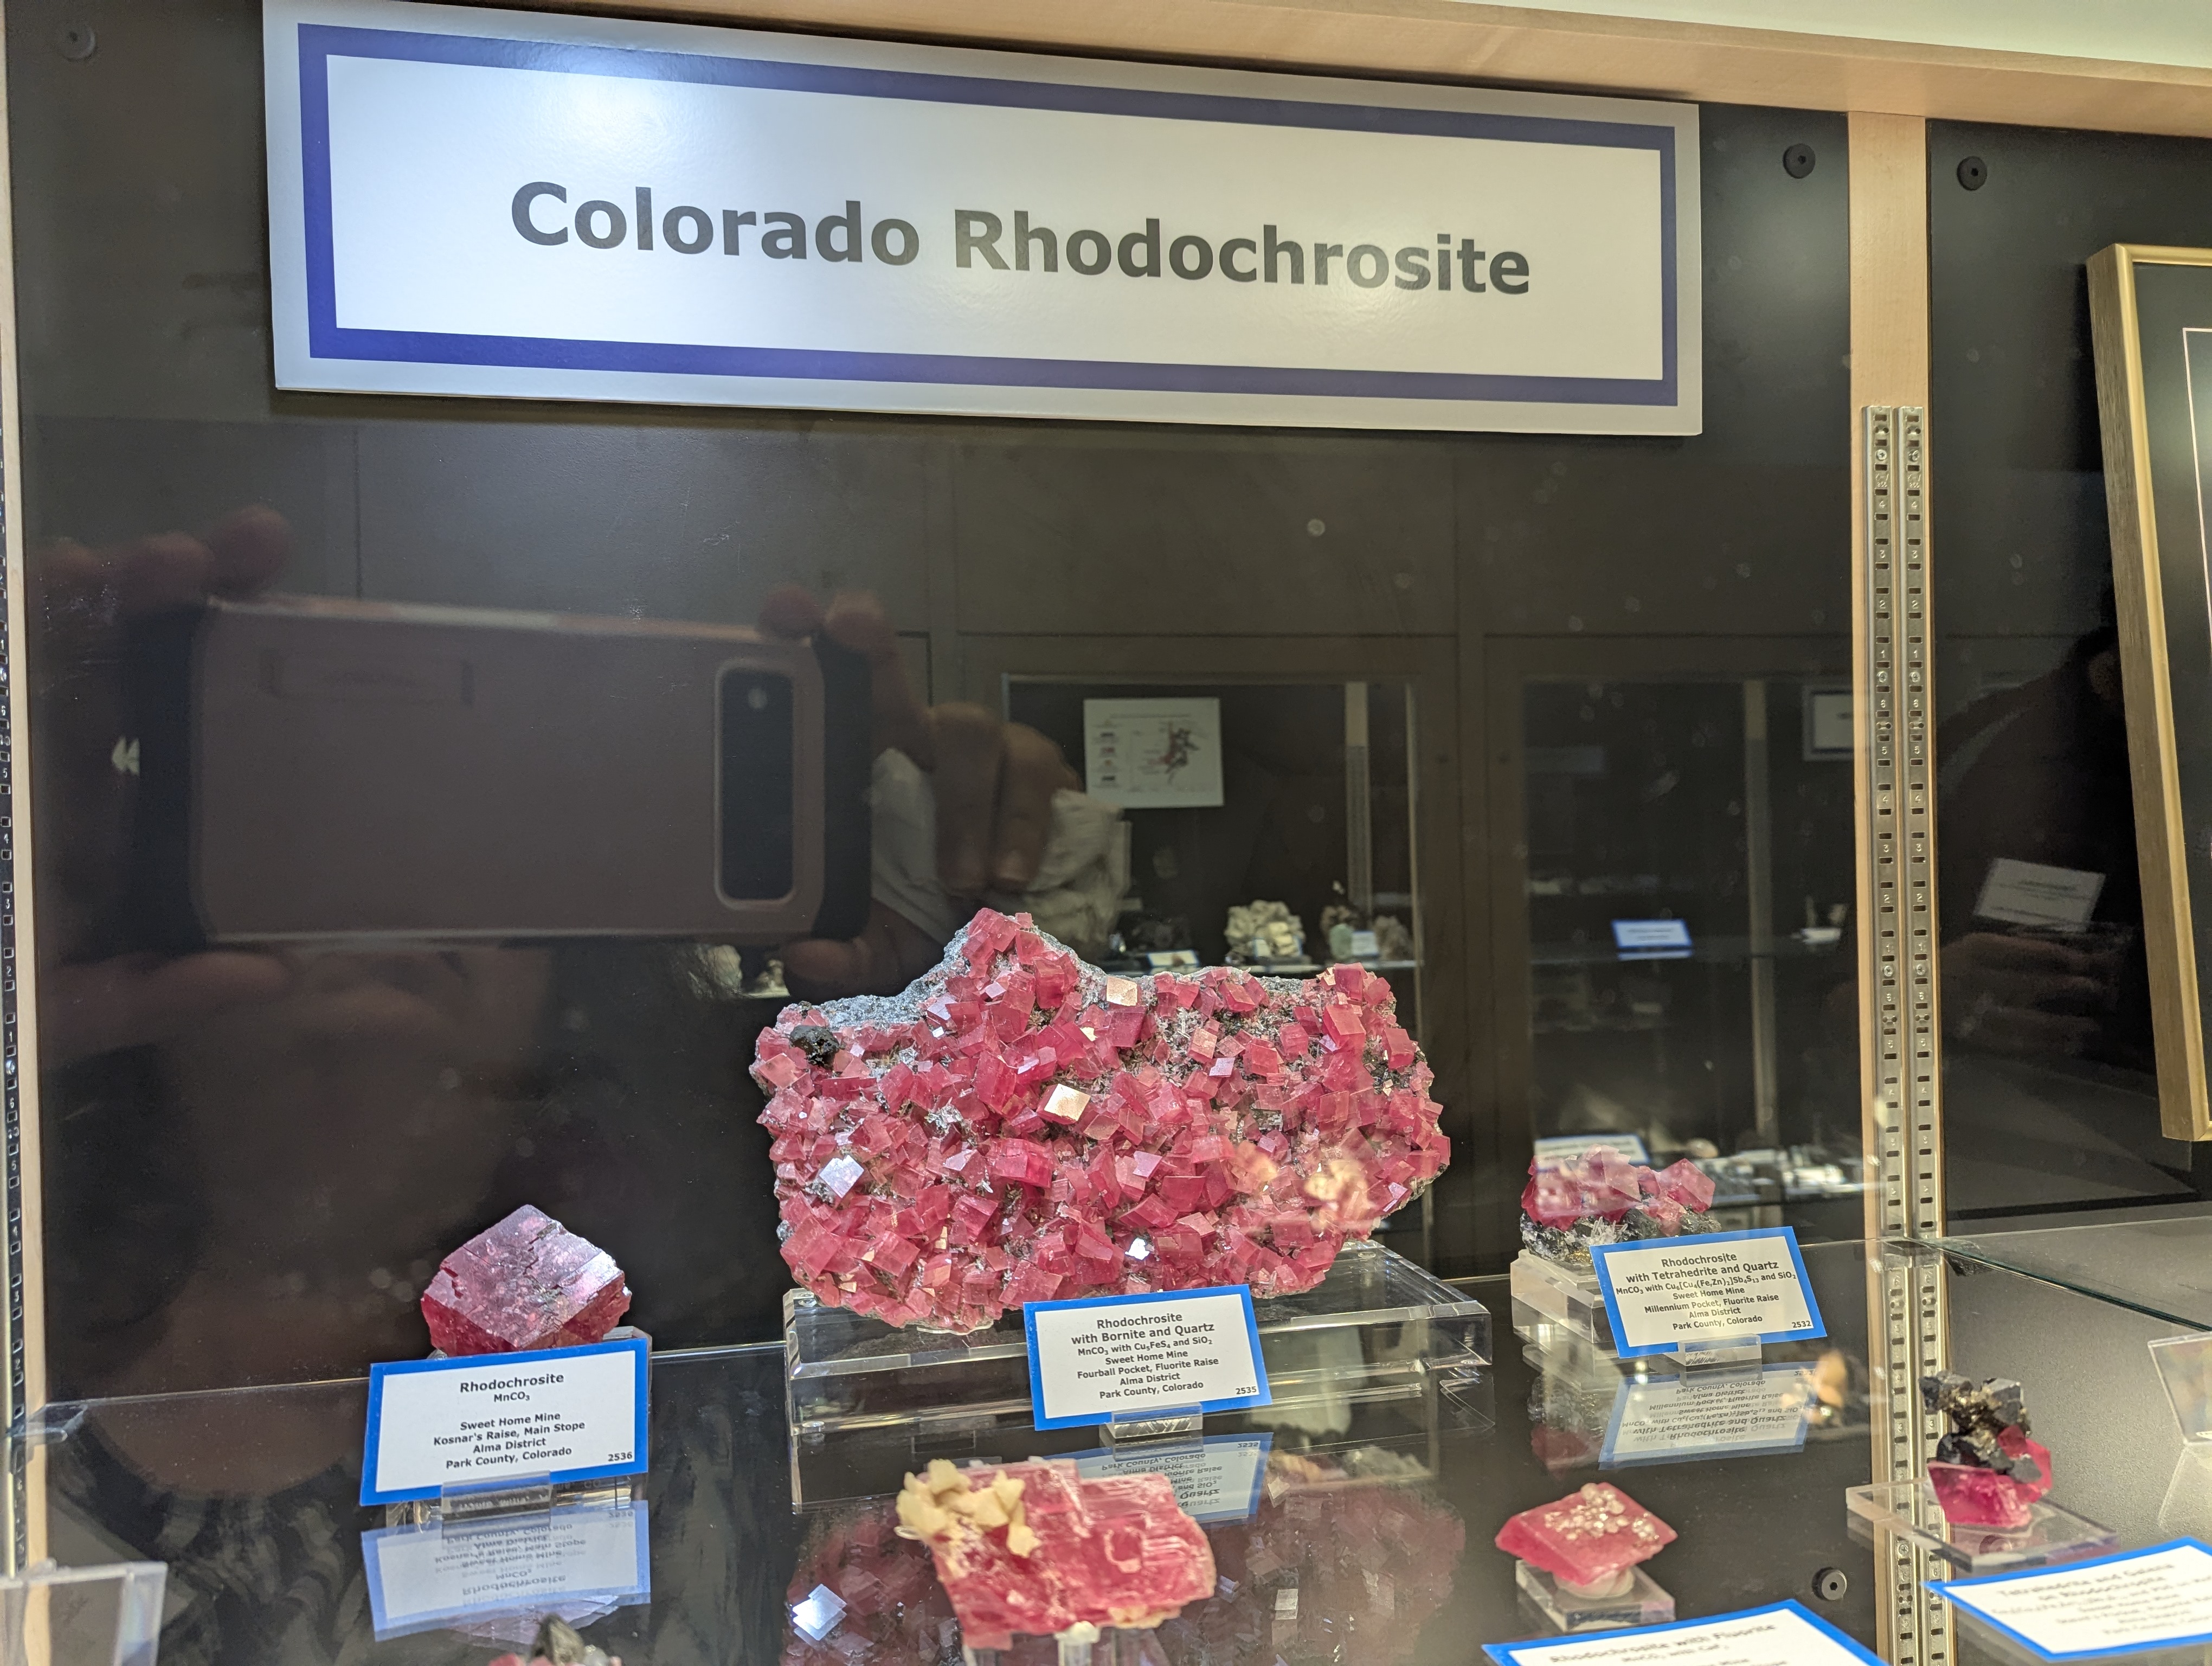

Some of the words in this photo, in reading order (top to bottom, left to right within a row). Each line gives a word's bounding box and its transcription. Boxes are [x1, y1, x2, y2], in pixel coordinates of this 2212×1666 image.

[511, 181, 919, 265] Colorado
[954, 209, 1530, 294] Rhodochrosite
[1661, 1253, 1738, 1267] Rhodochrosite
[1625, 1272, 1650, 1283] with
[1651, 1267, 1718, 1280] Tetrahedrite
[1720, 1264, 1740, 1274] and
[1742, 1261, 1779, 1273] Quartz
[1644, 1283, 1664, 1292] with
[1760, 1272, 1776, 1281] and
[1673, 1291, 1699, 1300] Sweet
[1725, 1287, 1745, 1295] Mine
[1644, 1303, 1690, 1313] Millennium
[1691, 1299, 1721, 1309] Pocket,
[1722, 1296, 1755, 1305] Fluorite
[1756, 1294, 1779, 1302] Raise
[1096, 1313, 1183, 1329] Rhodochrosite
[1689, 1311, 1709, 1319] Alma
[1711, 1306, 1741, 1316] District
[1672, 1321, 1693, 1330] Park
[1693, 1317, 1725, 1328] County,
[1726, 1315, 1763, 1325] Colorado
[1791, 1318, 1812, 1328] 2532
[1071, 1333, 1098, 1345] with
[1101, 1329, 1146, 1342] Bornite
[1149, 1326, 1171, 1337] and
[1174, 1323, 1215, 1336] Quartz
[1110, 1343, 1132, 1353] with
[1173, 1337, 1190, 1347] and
[1105, 1355, 1135, 1365] Sweet
[1136, 1353, 1164, 1362] Home
[1166, 1350, 1188, 1359] Mine
[1077, 1367, 1116, 1379] Fourball
[1118, 1364, 1153, 1375] Pocket,
[1155, 1361, 1192, 1371] Fluorite
[1193, 1357, 1219, 1367] Raise
[460, 1373, 564, 1393] Rhodochrosite
[1120, 1377, 1144, 1386] Alma
[1146, 1372, 1181, 1383] District
[1099, 1389, 1122, 1399] Park
[1123, 1386, 1160, 1396] County,
[1162, 1381, 1204, 1392] Colorado
[1235, 1386, 1256, 1395] 2535
[460, 1419, 496, 1431] Sweet
[499, 1417, 531, 1427] Home
[535, 1412, 561, 1422] Mine
[433, 1432, 483, 1446] Kosnar's
[486, 1429, 520, 1440] Raise,
[524, 1425, 550, 1436] Main
[554, 1422, 586, 1432] Stope
[472, 1444, 501, 1454] Alma
[505, 1437, 546, 1450] District
[446, 1458, 472, 1470] Park
[475, 1453, 518, 1466] County,
[522, 1446, 572, 1460] Colorado
[608, 1451, 633, 1462] 2536
